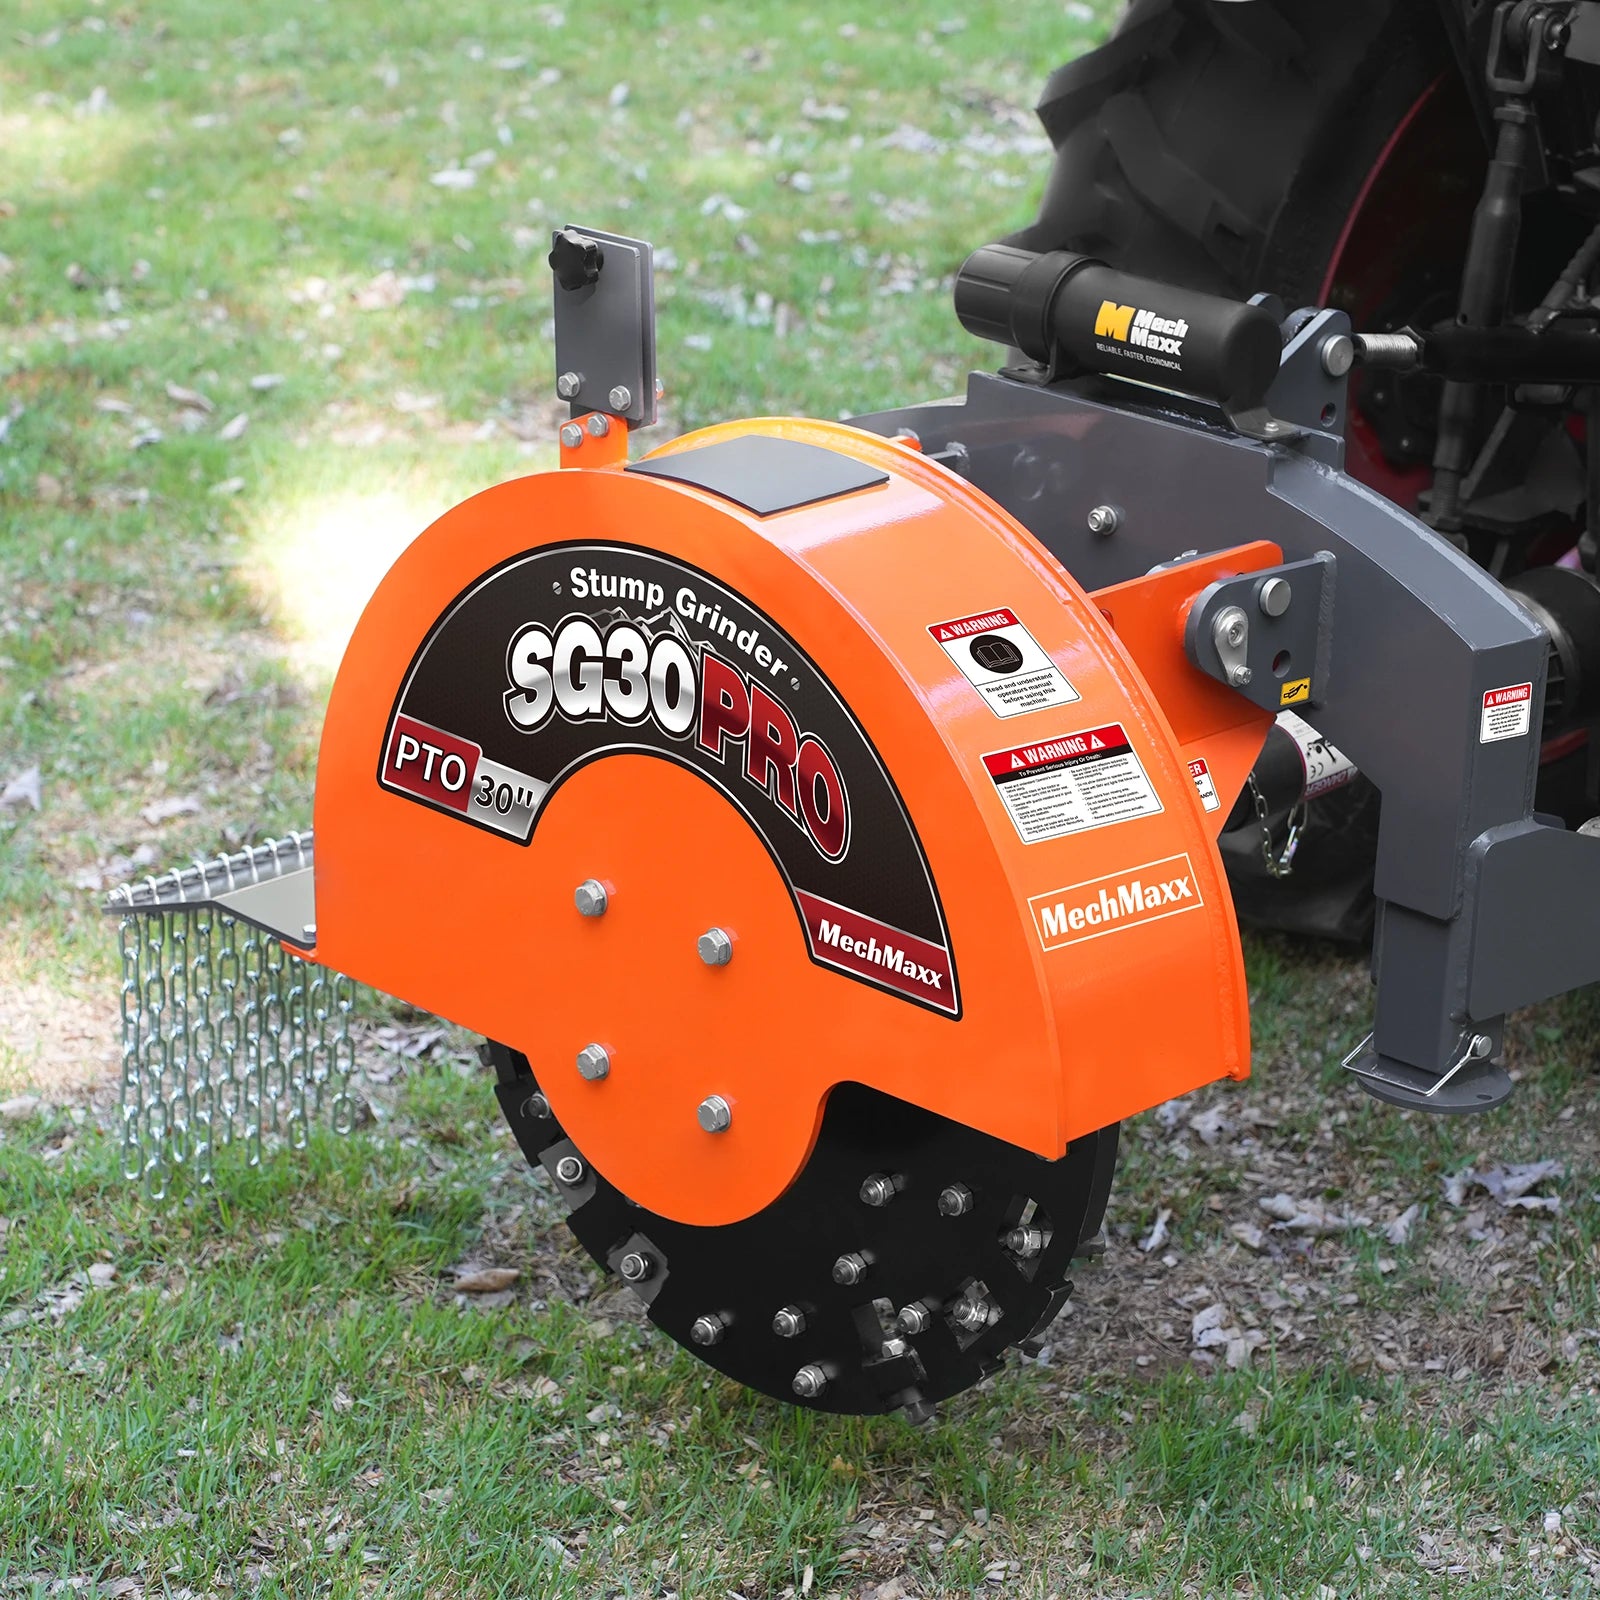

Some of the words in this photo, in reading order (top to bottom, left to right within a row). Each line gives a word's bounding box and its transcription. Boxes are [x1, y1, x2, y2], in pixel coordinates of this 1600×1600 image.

[1133, 309, 1189, 338] Mech
[1130, 326, 1182, 356] Maxx
[570, 567, 664, 609] Stump
[675, 587, 789, 677] Grinder
[949, 613, 1009, 636] WARNING
[985, 685, 1004, 693] Read
[1016, 673, 1053, 686] understand
[997, 687, 1028, 698] operators
[1028, 680, 1053, 691] manual
[1003, 695, 1024, 704] before
[1024, 691, 1044, 699] using
[1042, 687, 1056, 695] this
[1495, 687, 1528, 704] WARNING
[1020, 697, 1050, 707] machine.
[395, 733, 468, 792] PTO
[1023, 737, 1088, 764] WARNING
[1064, 758, 1079, 767] Injury
[1040, 876, 1193, 939] MechMaxx
[818, 919, 943, 990] MechMaxx
